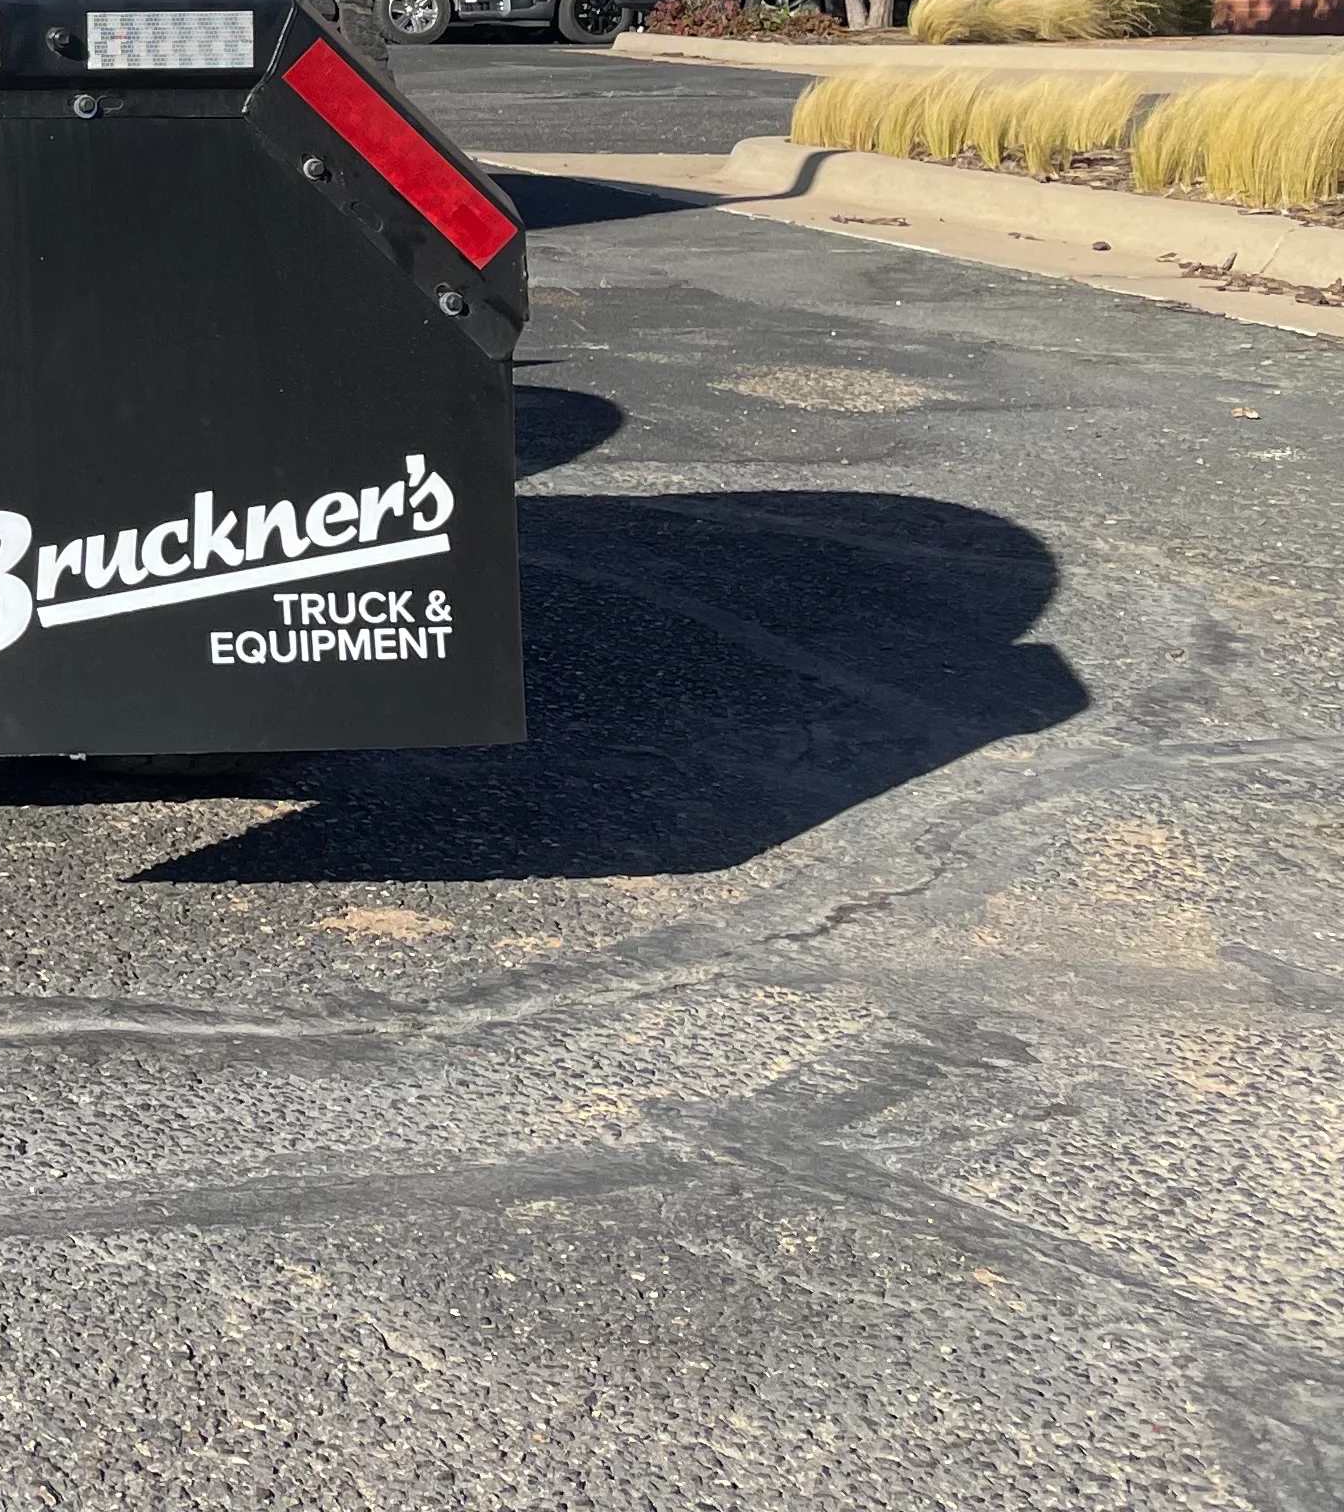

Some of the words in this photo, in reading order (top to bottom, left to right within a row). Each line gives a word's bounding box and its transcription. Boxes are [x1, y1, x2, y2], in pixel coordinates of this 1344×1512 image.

[273, 591, 416, 626] TRUCK
[425, 589, 453, 623] &
[210, 626, 453, 665] EQUIPMENT
